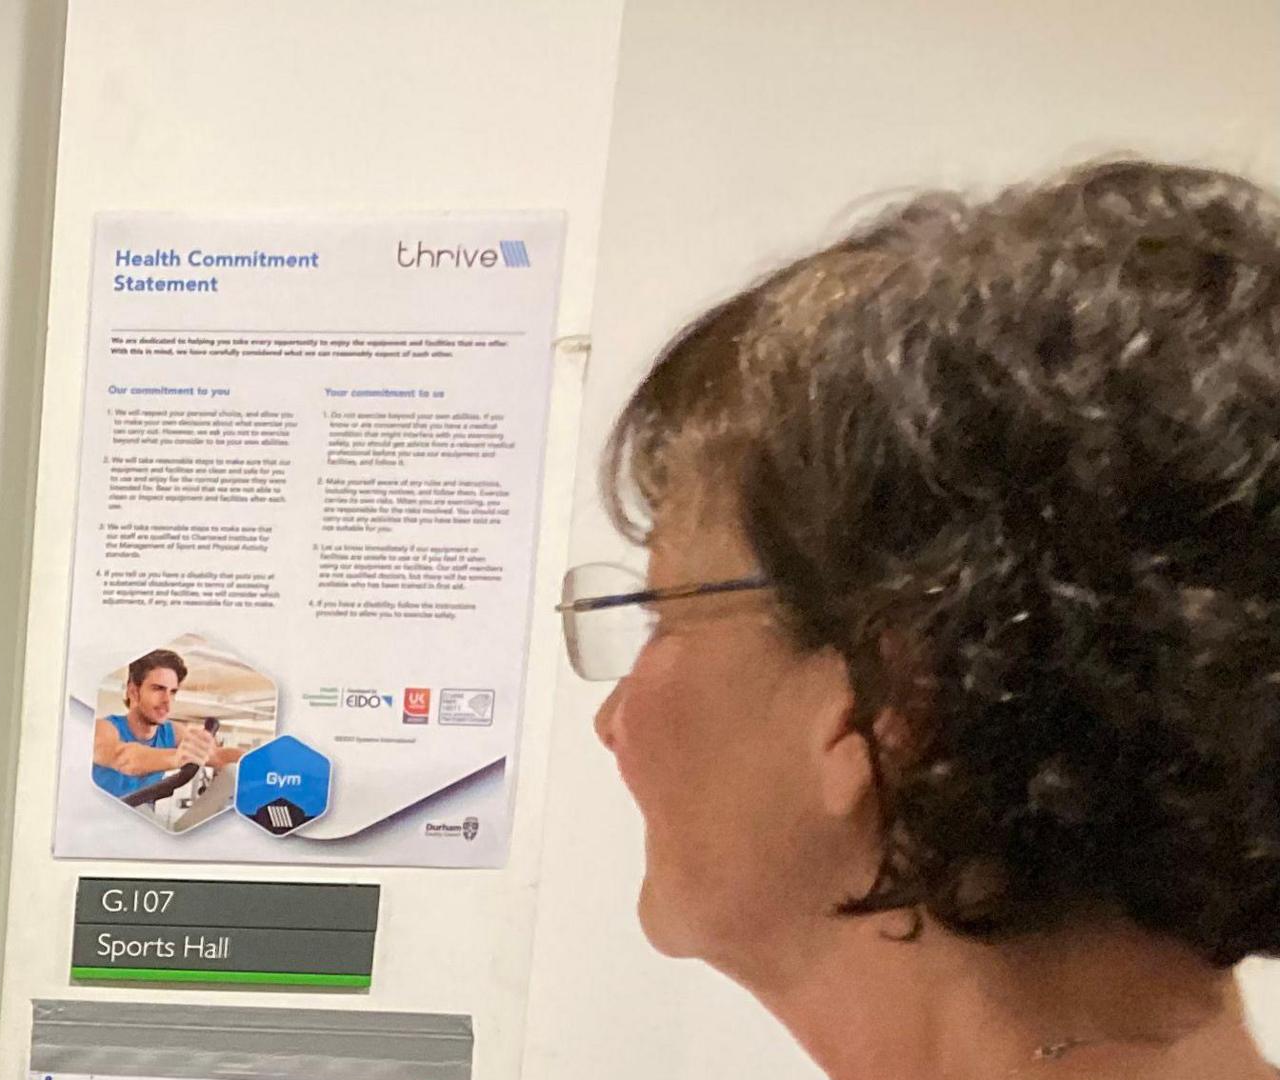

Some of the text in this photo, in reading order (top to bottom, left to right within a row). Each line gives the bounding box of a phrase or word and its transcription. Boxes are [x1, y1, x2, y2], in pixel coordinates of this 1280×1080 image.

[116, 250, 319, 269] Health Commitment
[397, 241, 497, 268] thrive
[114, 276, 218, 293] Statement
[108, 384, 230, 399] Our commitment to you
[325, 387, 444, 399] Your commitment to us
[266, 772, 302, 788] Gym
[426, 824, 462, 832] Durham
[102, 890, 174, 914] G.107
[97, 934, 229, 962] Sports Hall
